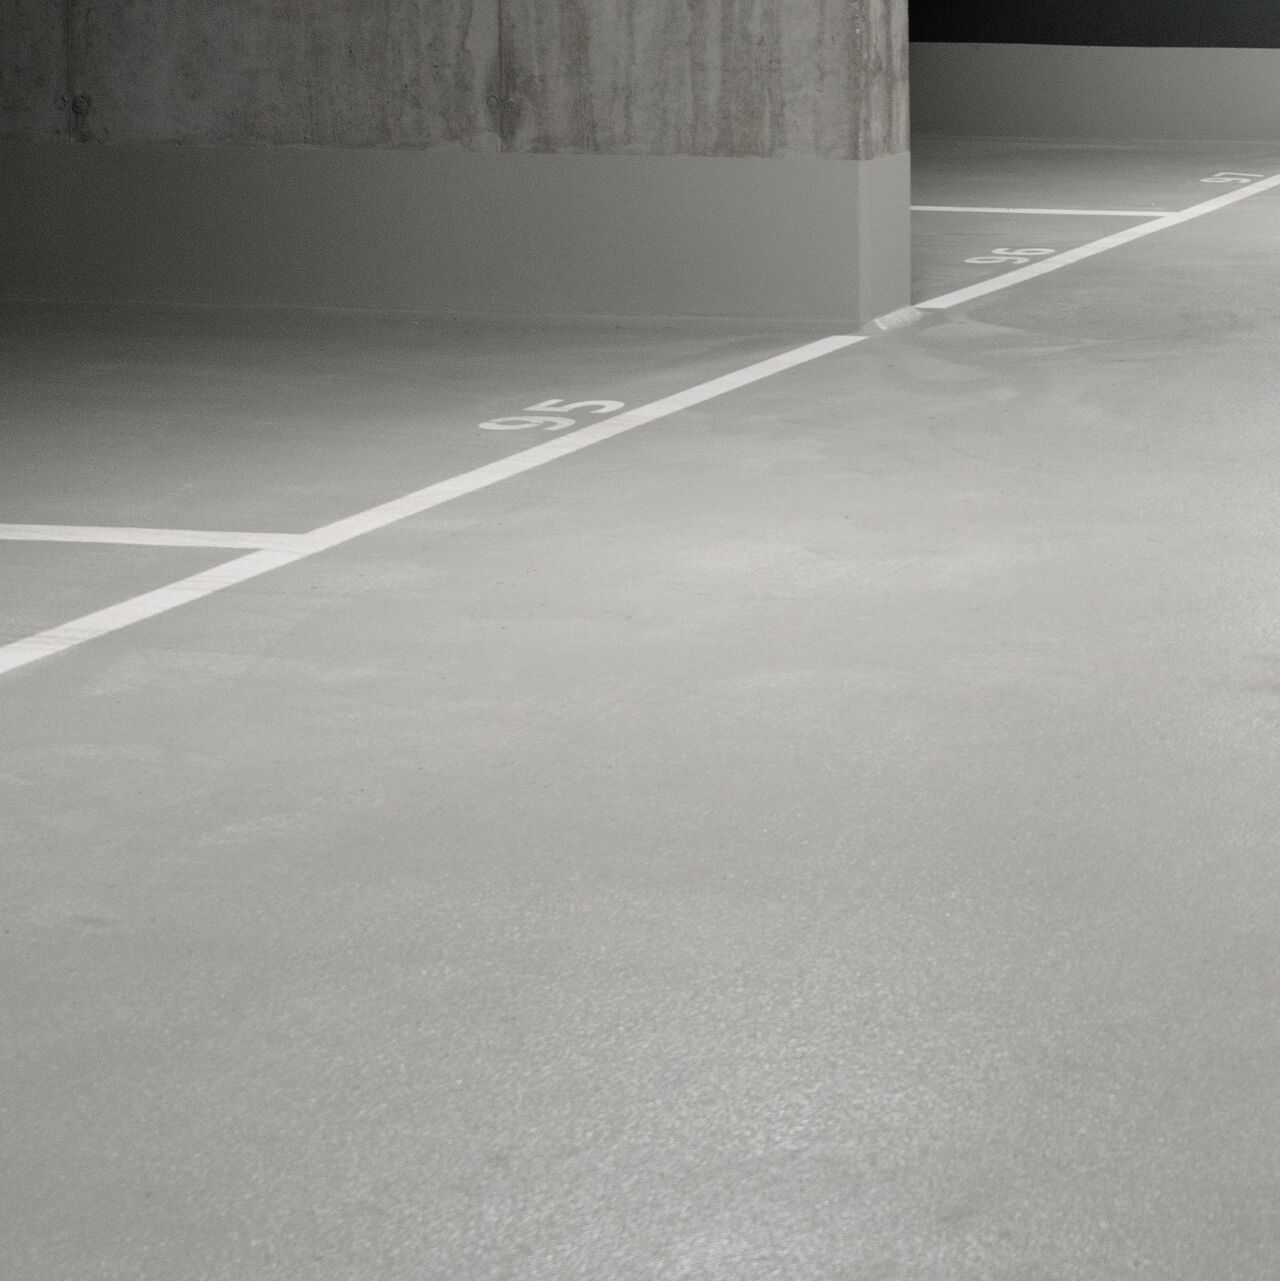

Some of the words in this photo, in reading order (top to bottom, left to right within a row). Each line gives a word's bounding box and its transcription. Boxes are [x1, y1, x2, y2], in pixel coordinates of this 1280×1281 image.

[1199, 171, 1264, 183] 97
[963, 247, 1056, 265] 96
[477, 398, 626, 432] 95
